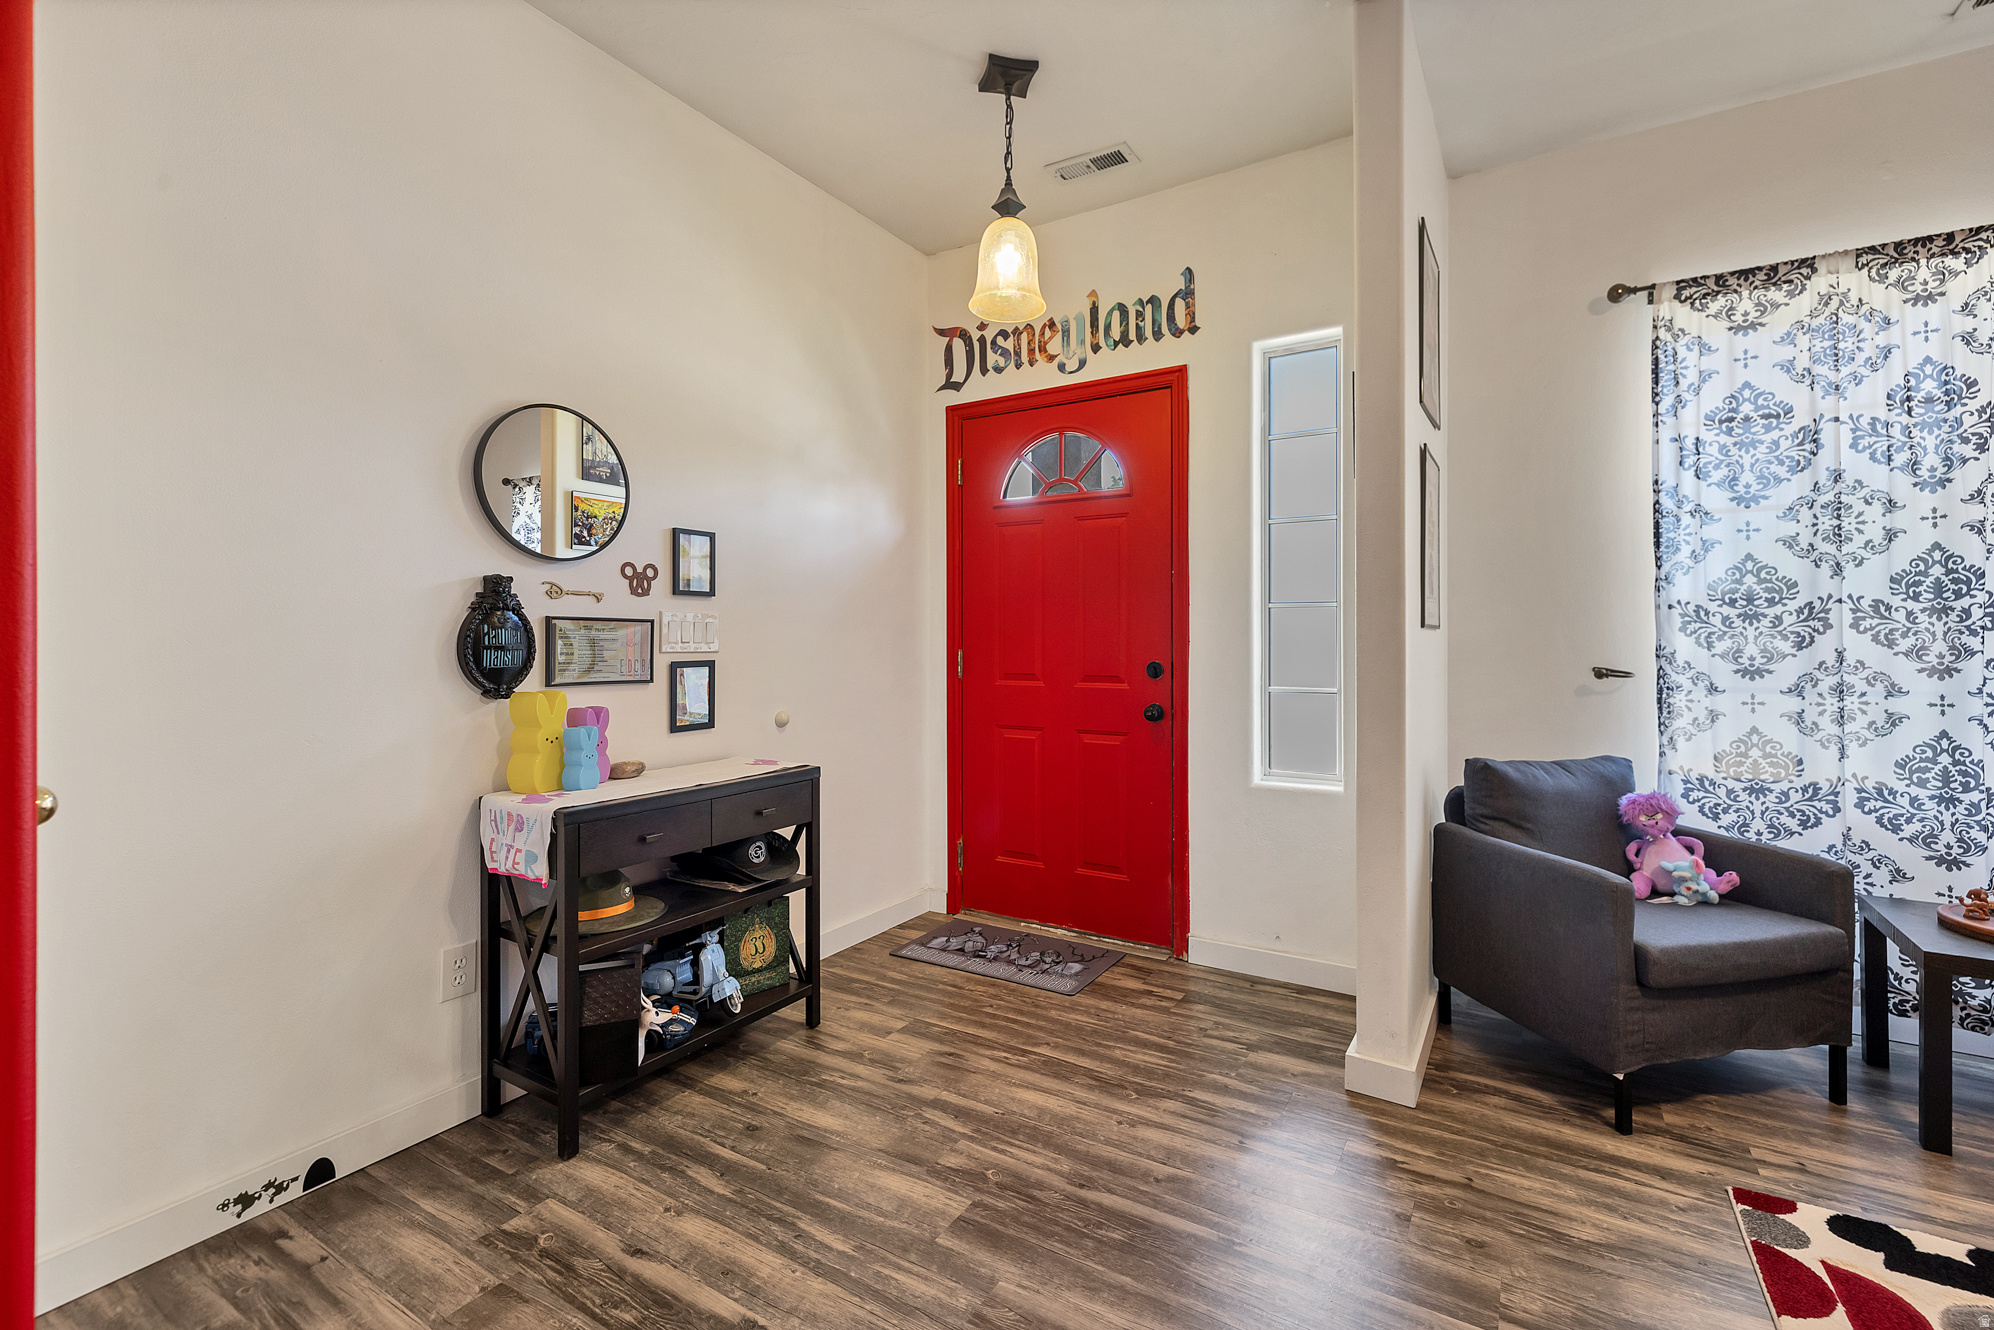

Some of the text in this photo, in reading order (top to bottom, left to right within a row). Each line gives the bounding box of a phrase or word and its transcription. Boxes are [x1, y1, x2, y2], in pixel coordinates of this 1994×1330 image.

[932, 266, 1202, 393] Disneyland
[480, 647, 523, 671] Mansion
[750, 934, 766, 957] 33
[901, 943, 1077, 991] Welcome Foolish Mortals
